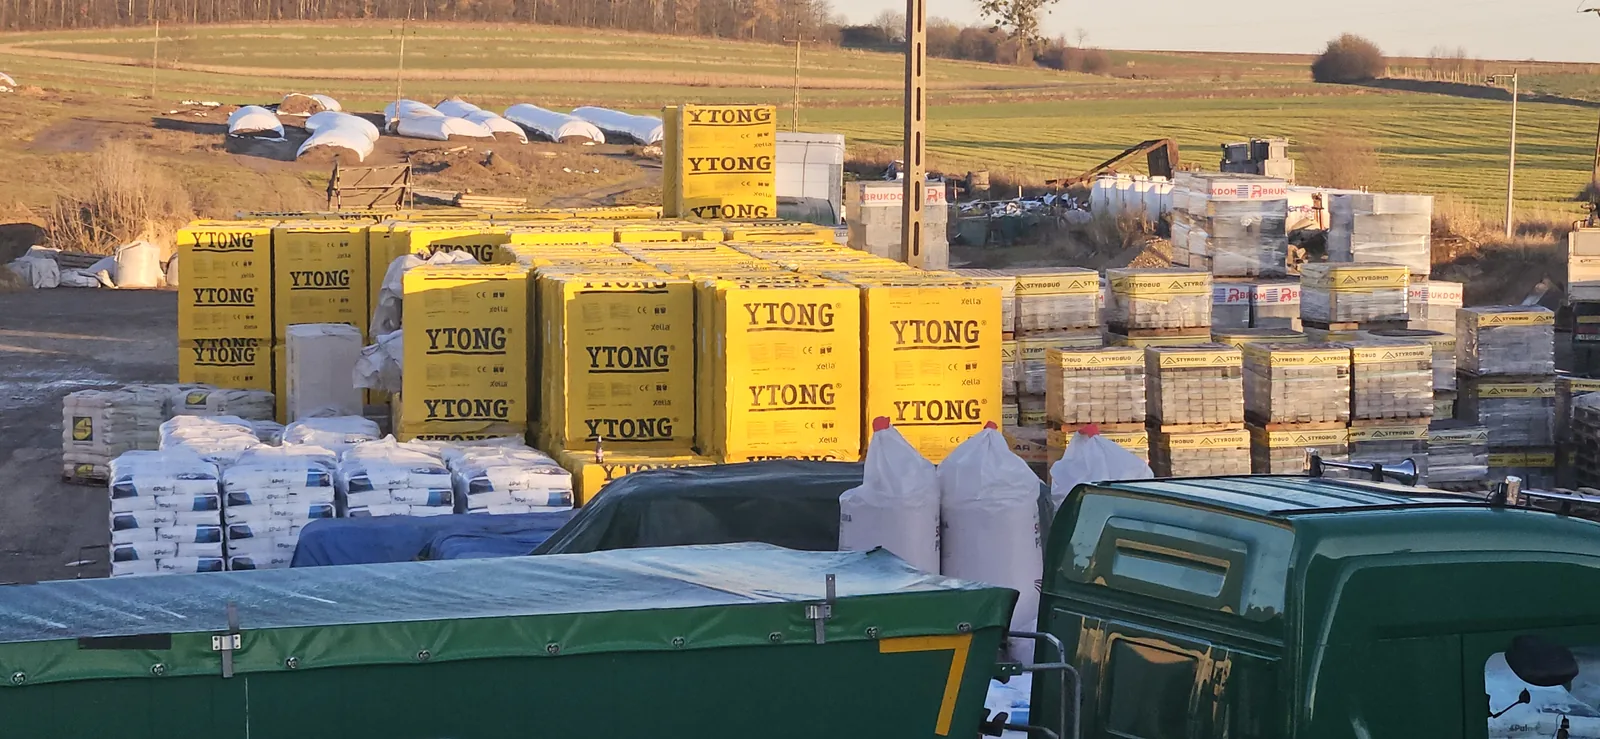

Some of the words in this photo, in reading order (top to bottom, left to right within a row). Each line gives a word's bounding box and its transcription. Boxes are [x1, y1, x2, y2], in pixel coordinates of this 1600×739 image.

[687, 108, 771, 123] YTONG
[688, 156, 771, 171] YTONG
[691, 204, 768, 219] YTONG
[192, 231, 254, 249] YTONG
[290, 270, 350, 286] YTONG
[193, 288, 255, 303] YTONG
[745, 302, 835, 327] YTONG
[426, 328, 507, 350] YTONG
[890, 319, 980, 344] YTONG
[194, 348, 255, 363] YTONG
[586, 345, 670, 368] YTONG
[749, 384, 835, 406] YTONG
[424, 399, 509, 418] YTONG
[894, 400, 981, 421] YTONG
[585, 418, 673, 438] YTONG
[879, 633, 973, 736] 7
